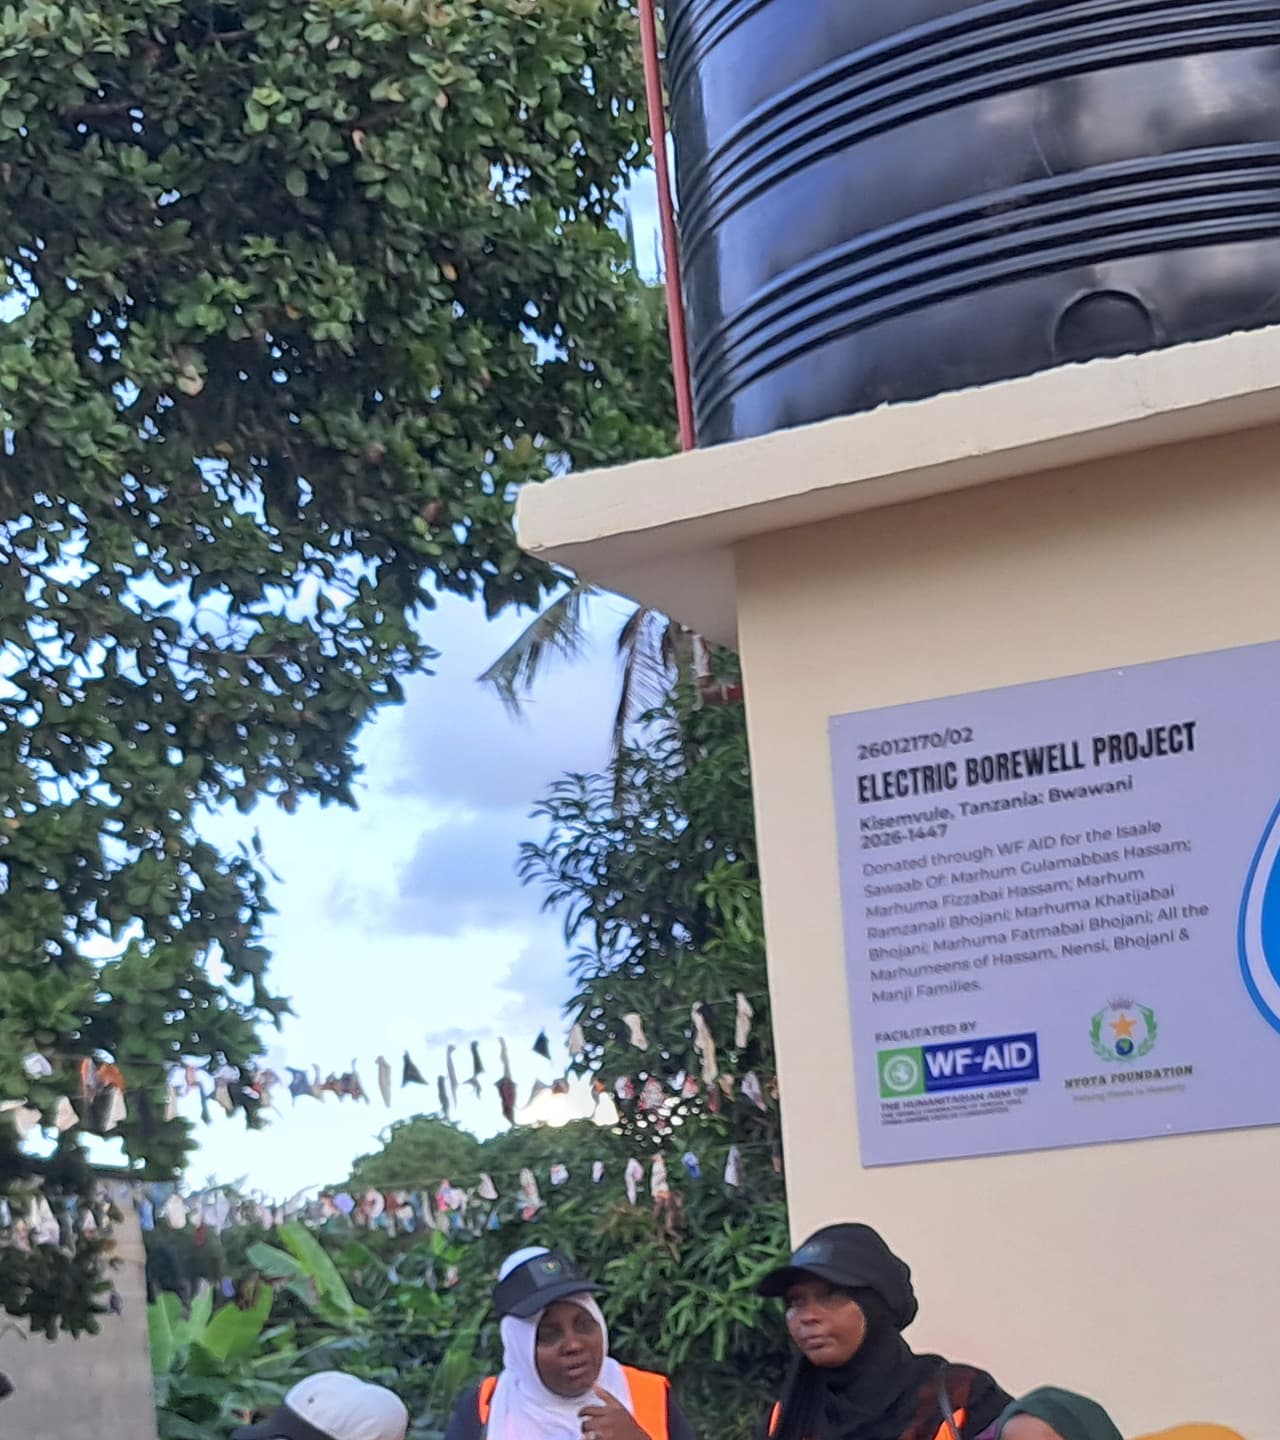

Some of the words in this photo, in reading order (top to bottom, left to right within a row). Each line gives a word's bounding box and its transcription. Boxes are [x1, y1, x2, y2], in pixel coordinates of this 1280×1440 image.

[857, 726, 974, 760] 26012170/02
[858, 761, 958, 804] ELECTRIC
[965, 741, 1085, 787] BOREWELL
[1092, 721, 1197, 764] PROJECT
[860, 806, 955, 832] Kisemvule,
[1048, 775, 1133, 803] Bwawani
[860, 823, 948, 849] 2026-1447
[862, 856, 927, 877] Donated
[931, 845, 993, 866] through
[996, 839, 1024, 855] WF
[1027, 836, 1056, 851] AID
[1060, 833, 1081, 846] for
[1085, 828, 1112, 843] the
[1116, 820, 1162, 839] Isaale
[864, 878, 922, 898] Sawaab
[950, 865, 1017, 885] Marhum
[1020, 850, 1120, 875] Gulamabbas
[865, 899, 938, 919] Marhuma
[942, 888, 1003, 907] Fizzabai
[1076, 868, 1144, 888] Marhum
[867, 917, 944, 940] Ramzanali
[1015, 899, 1090, 919] Marhuma
[1095, 884, 1175, 908] Khatijabai
[933, 932, 1007, 952] Marhuma
[1011, 919, 1084, 941] Fatmabai
[1156, 906, 1177, 922] All
[1182, 903, 1209, 919] the
[870, 959, 970, 982] Marhumeens
[973, 954, 989, 969] of
[1113, 929, 1174, 950] Bhojani
[1178, 927, 1190, 941] &
[875, 1023, 956, 1043] FACILITATED
[960, 1020, 977, 1033] BY
[925, 1041, 1033, 1078] WF-AID
[1111, 1065, 1193, 1083] FOUNDATION
